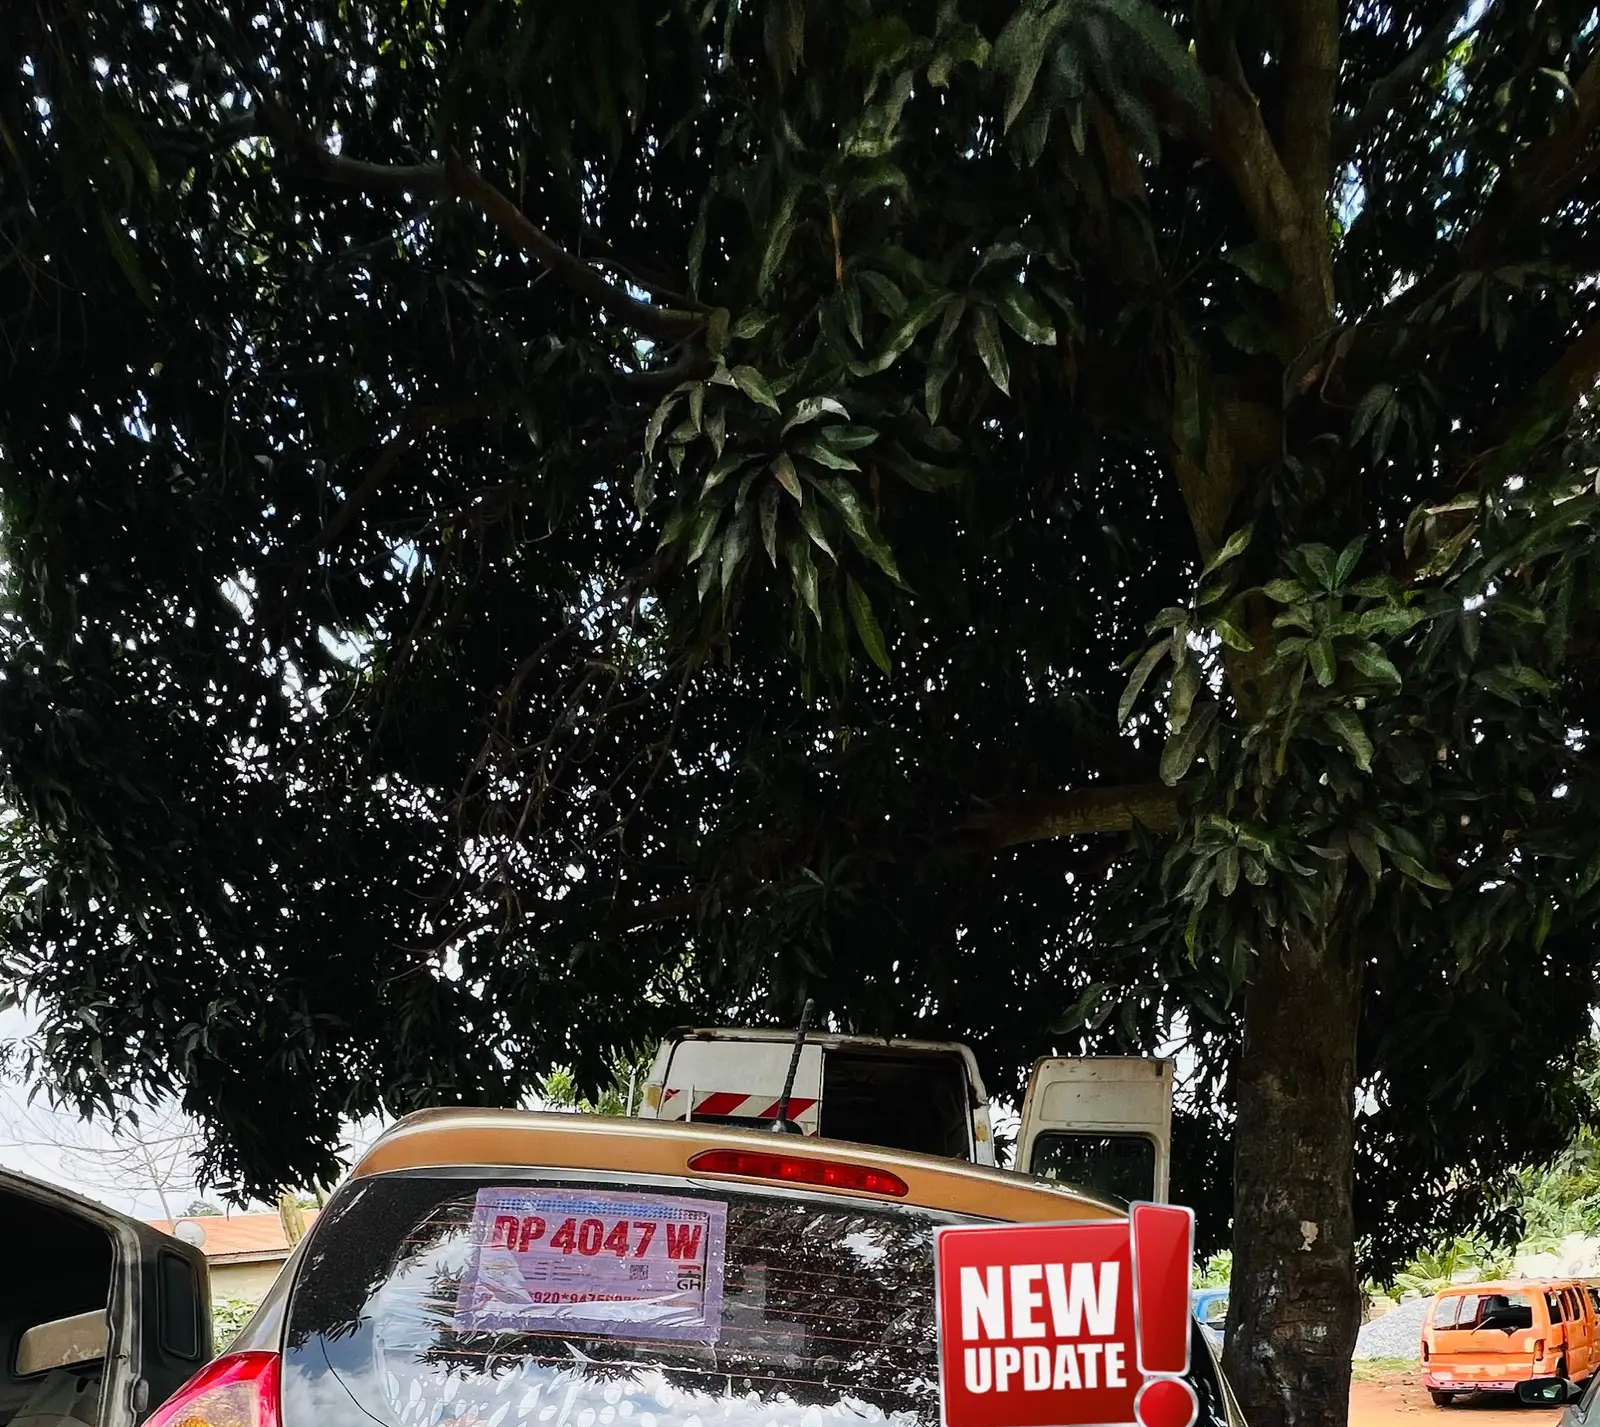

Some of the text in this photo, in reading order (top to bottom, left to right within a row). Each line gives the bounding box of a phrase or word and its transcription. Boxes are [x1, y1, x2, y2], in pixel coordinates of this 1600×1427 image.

[492, 1215, 701, 1260] DP 4047 W
[676, 1279, 701, 1291] GH
